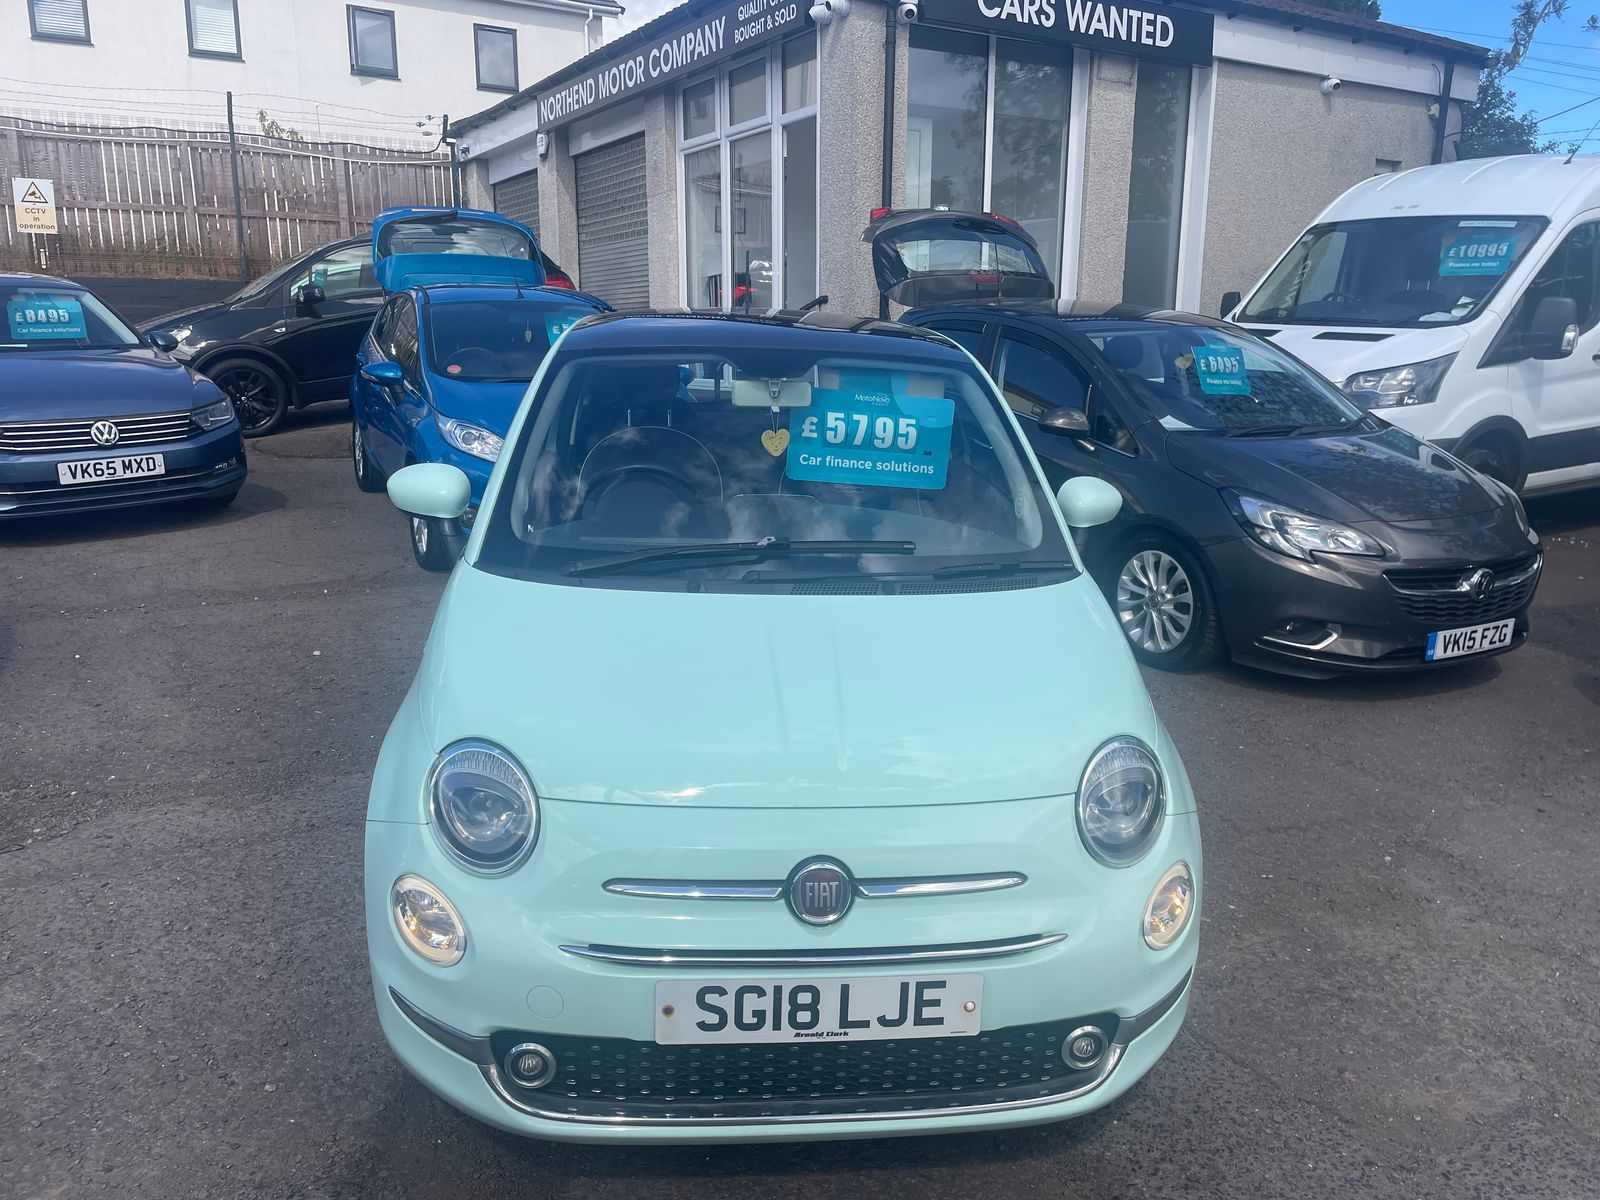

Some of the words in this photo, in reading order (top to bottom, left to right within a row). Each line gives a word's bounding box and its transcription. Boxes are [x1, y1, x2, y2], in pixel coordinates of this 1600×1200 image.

[734, 17, 765, 44] BOUGHT
[766, 14, 773, 30] &
[774, 3, 797, 27] SOLD
[738, 0, 768, 21] QUALITY
[977, 0, 1056, 28] CARS
[1065, 0, 1174, 48] WANTED
[540, 78, 595, 124] NORTHEND
[599, 55, 645, 100] MOTOR
[649, 16, 726, 78] COMPANY
[66, 460, 117, 480] VK65
[122, 457, 157, 475] MXD
[800, 454, 822, 466] Car
[825, 455, 873, 469] finance
[876, 460, 934, 474] solutions
[1443, 629, 1478, 654] VK15
[1480, 623, 1509, 648] FZG
[805, 881, 839, 908] FIAT
[695, 983, 821, 1032] SG18
[838, 980, 947, 1029] LJE
